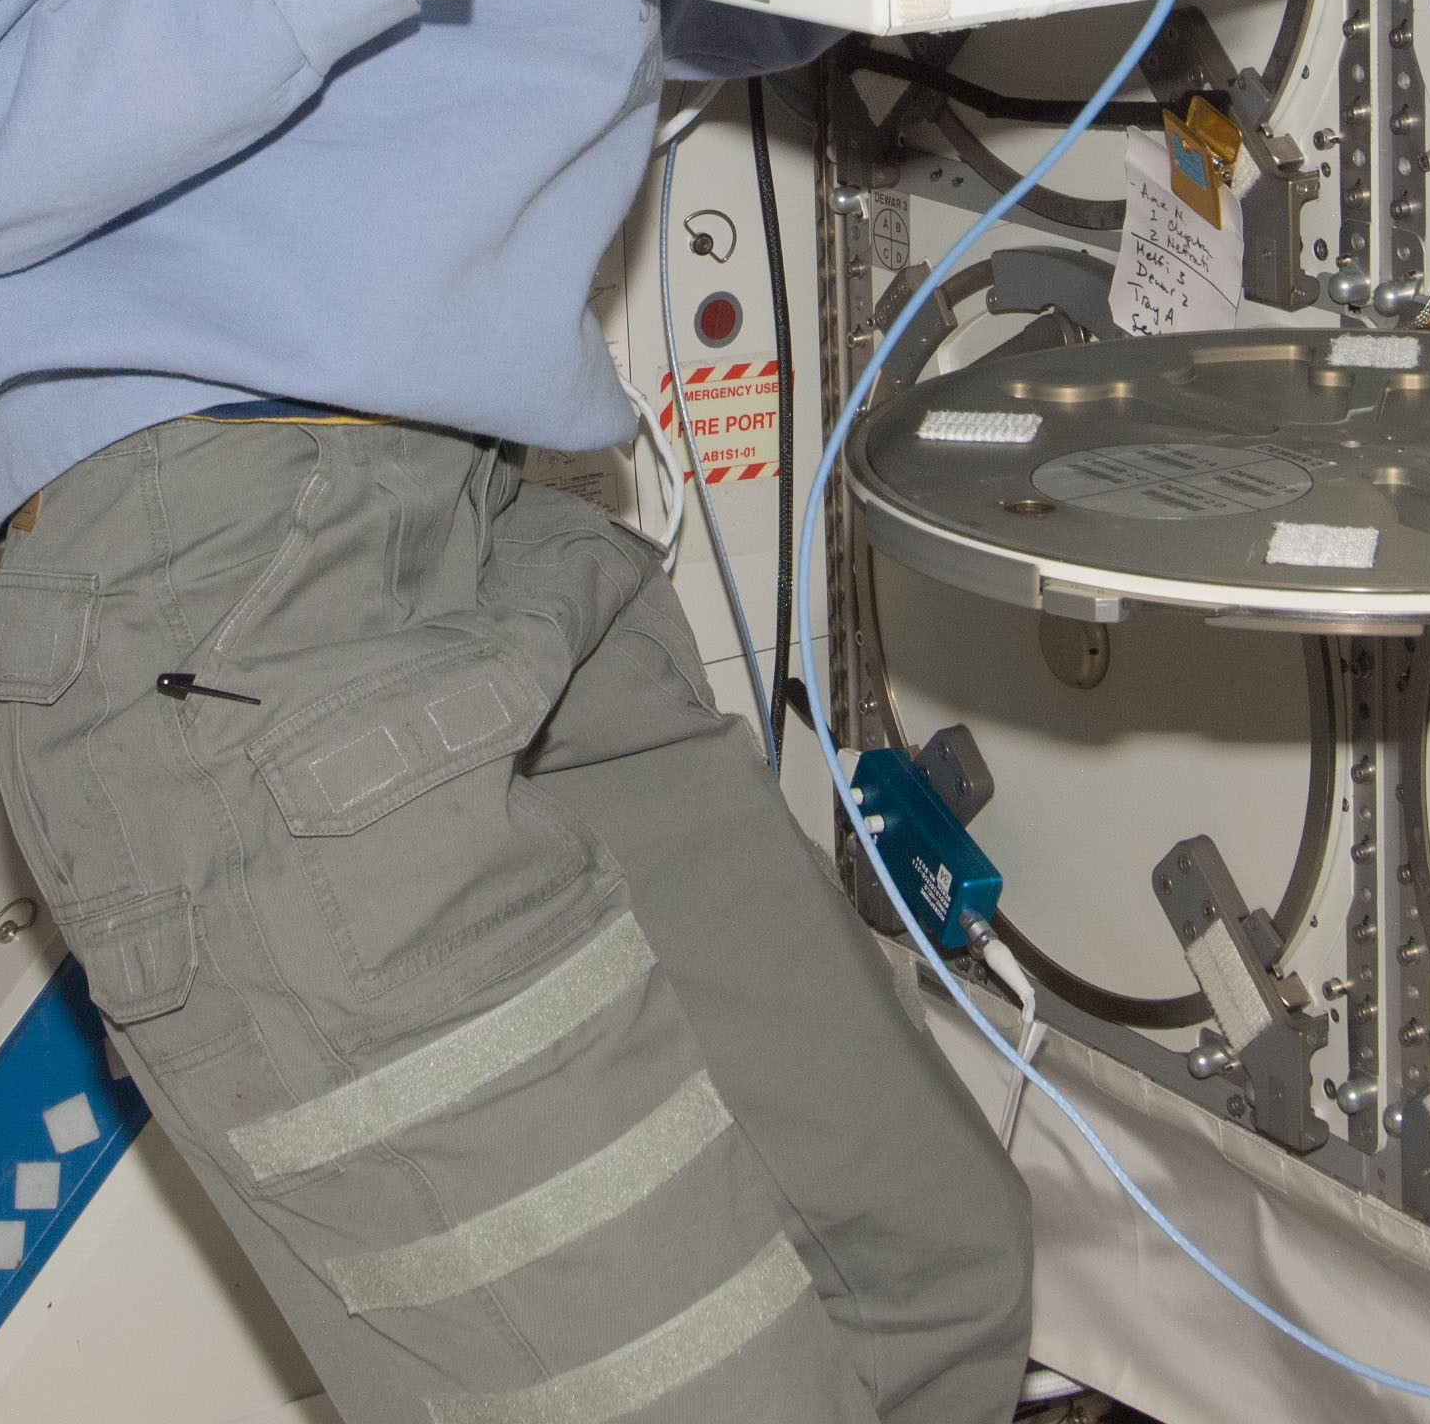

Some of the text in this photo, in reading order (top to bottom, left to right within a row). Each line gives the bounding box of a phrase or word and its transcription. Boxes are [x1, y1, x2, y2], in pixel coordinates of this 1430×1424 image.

[874, 192, 907, 211] DEWAR 3
[883, 218, 888, 229] A
[1150, 229, 1158, 241] 2
[884, 248, 901, 263] C D
[1165, 308, 1174, 325] A
[684, 382, 779, 402] MERGENCY USE
[726, 411, 777, 433] PORT
[701, 447, 756, 463] AB1S1-01
